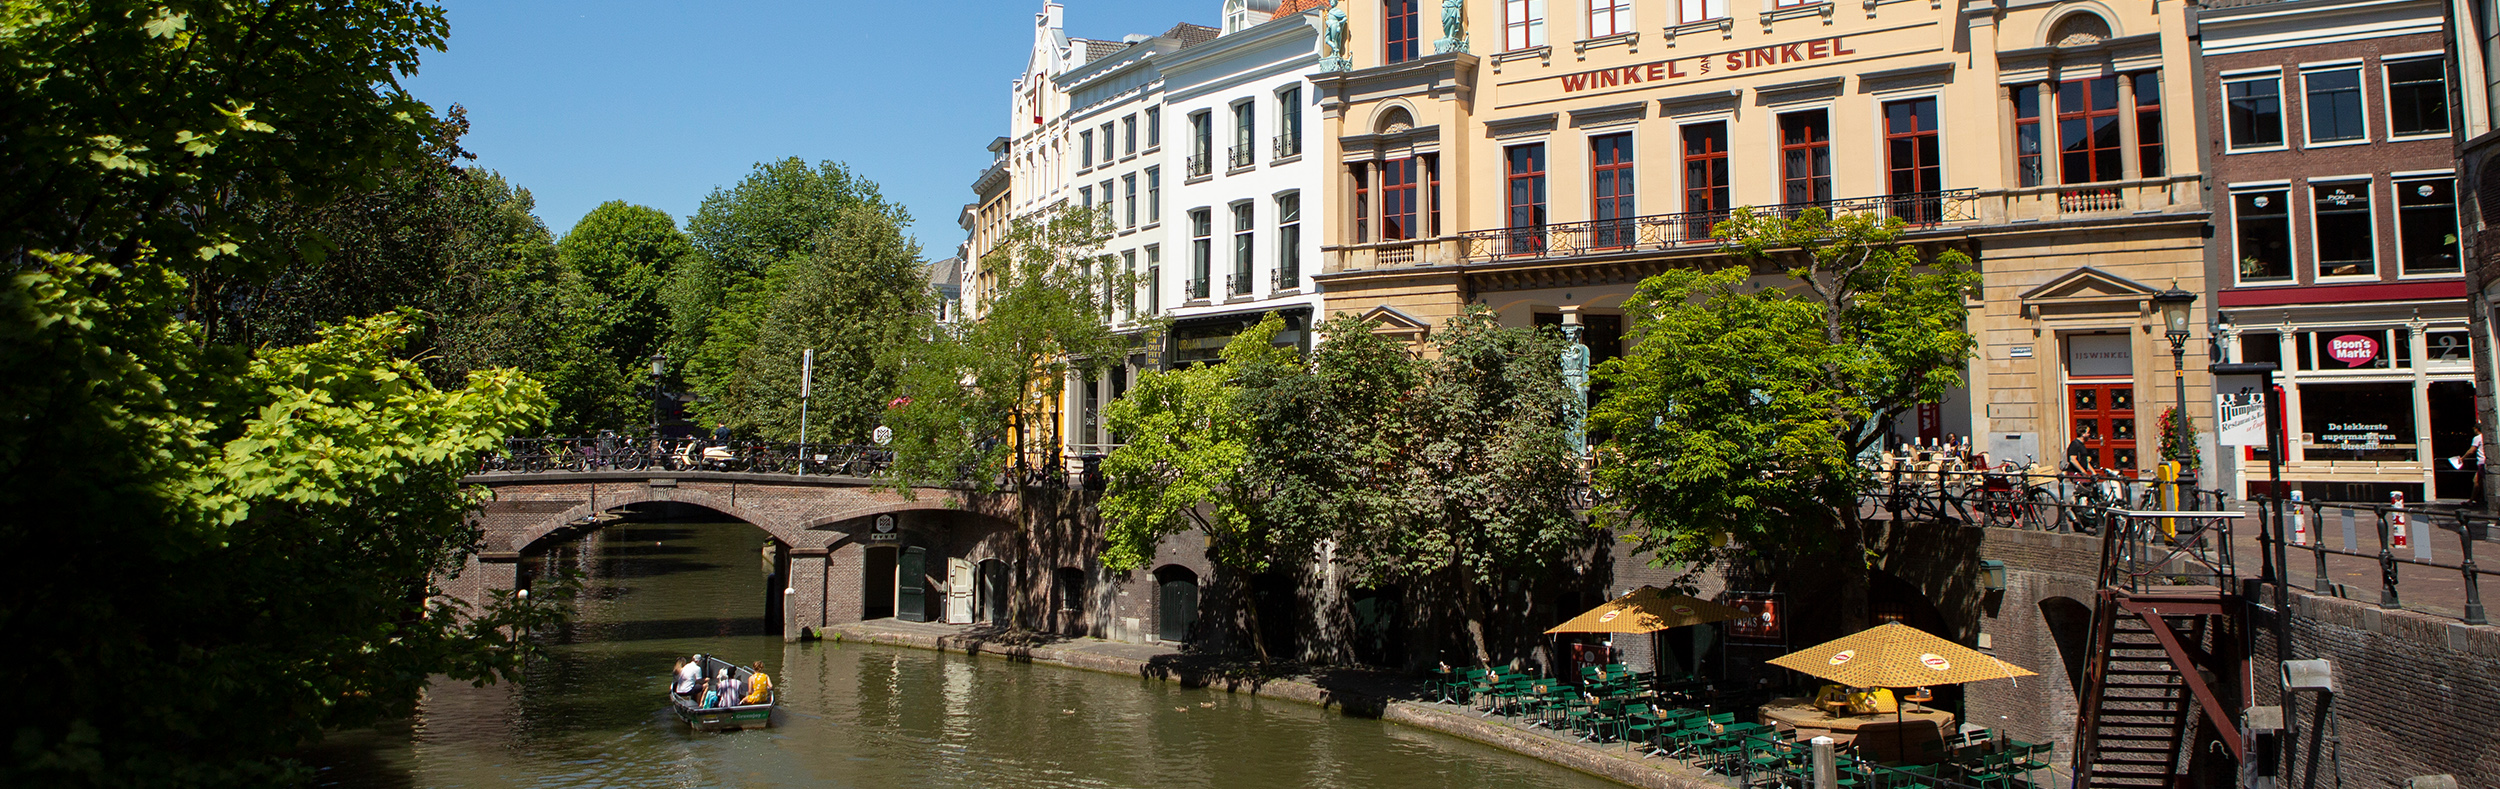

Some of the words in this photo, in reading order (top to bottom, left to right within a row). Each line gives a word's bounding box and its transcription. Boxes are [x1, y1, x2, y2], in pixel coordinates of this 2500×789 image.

[1561, 61, 1687, 93] WINKEL
[1700, 56, 1711, 75] VAN
[1726, 37, 1856, 71] SINKEL
[2333, 339, 2371, 350] Boon's
[2075, 351, 2130, 360] IJSWINKEL
[2336, 348, 2371, 359] Markt
[2438, 336, 2458, 365] 2
[2328, 423, 2343, 431] De
[2343, 423, 2389, 431] lekkerste
